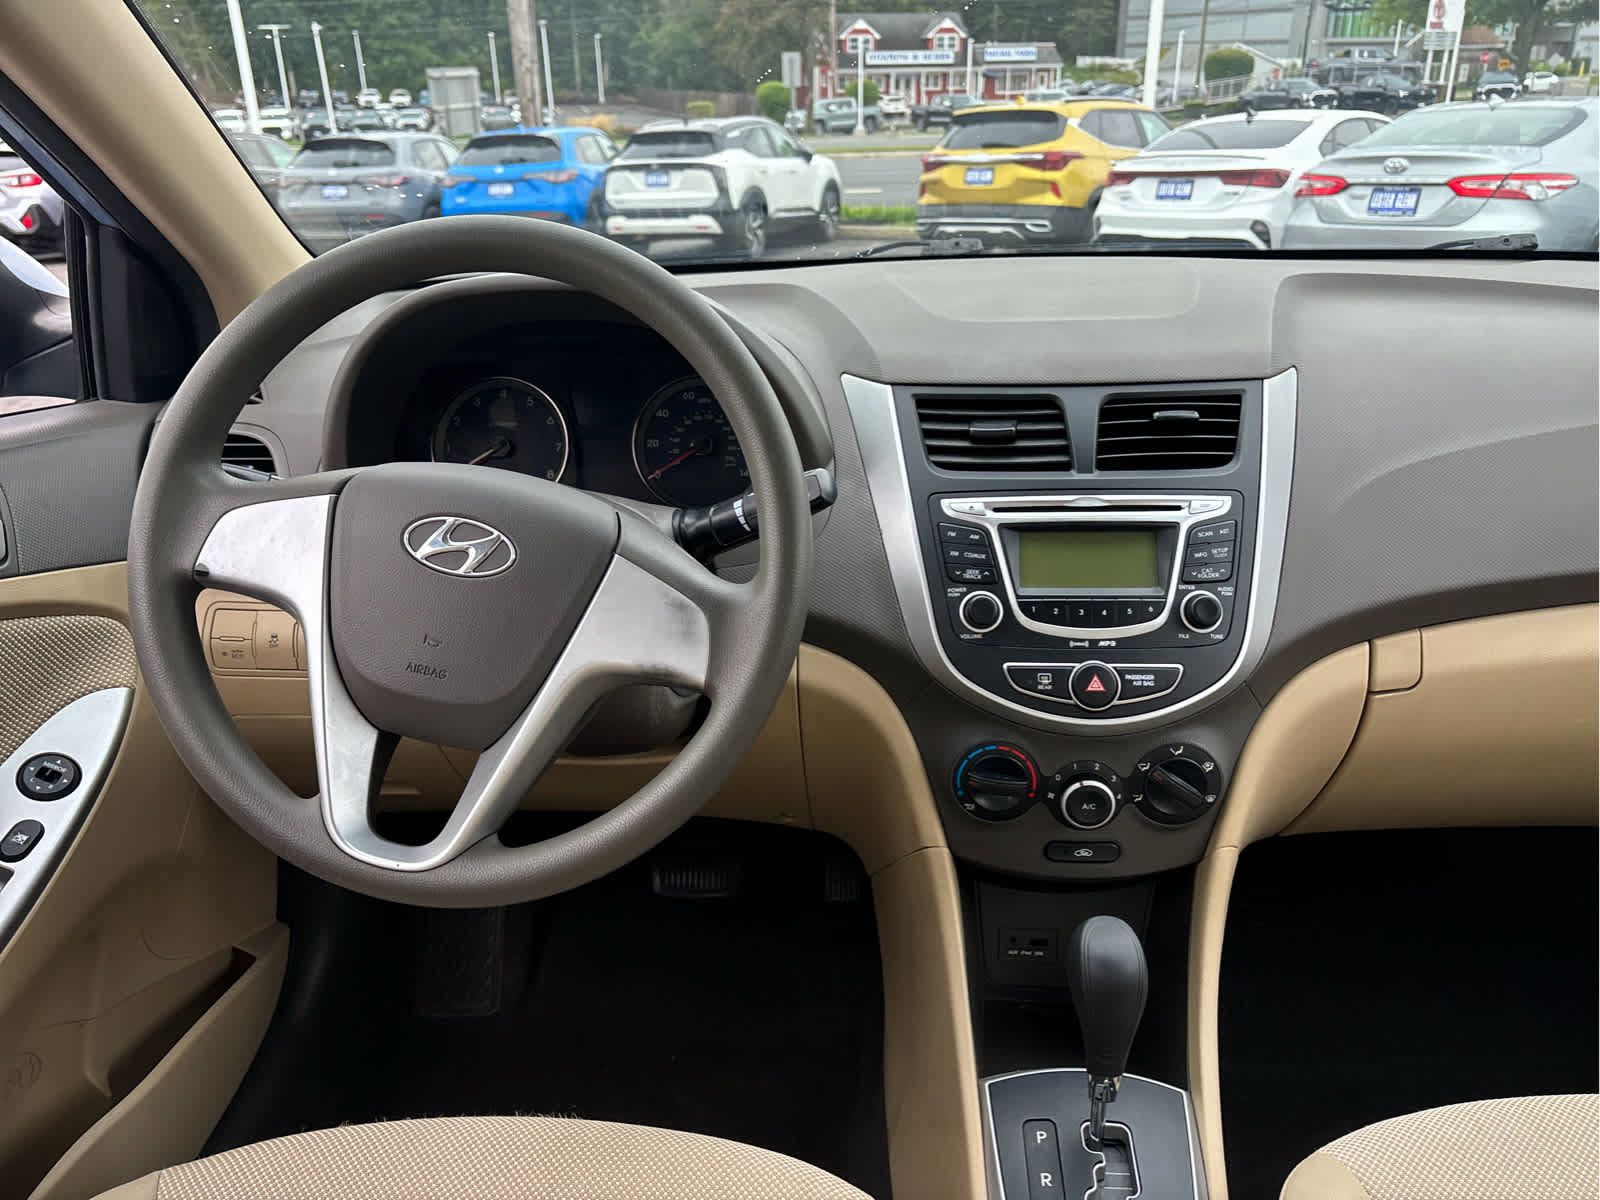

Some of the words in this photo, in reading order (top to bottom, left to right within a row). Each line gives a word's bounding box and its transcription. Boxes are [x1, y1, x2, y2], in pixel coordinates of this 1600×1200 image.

[682, 391, 695, 400] 60
[656, 408, 669, 417] 40
[647, 439, 659, 448] 20
[405, 661, 448, 680] AIRBAG
[1081, 803, 1096, 811] A/C
[1036, 1130, 1047, 1143] P
[1040, 1172, 1052, 1187] R
